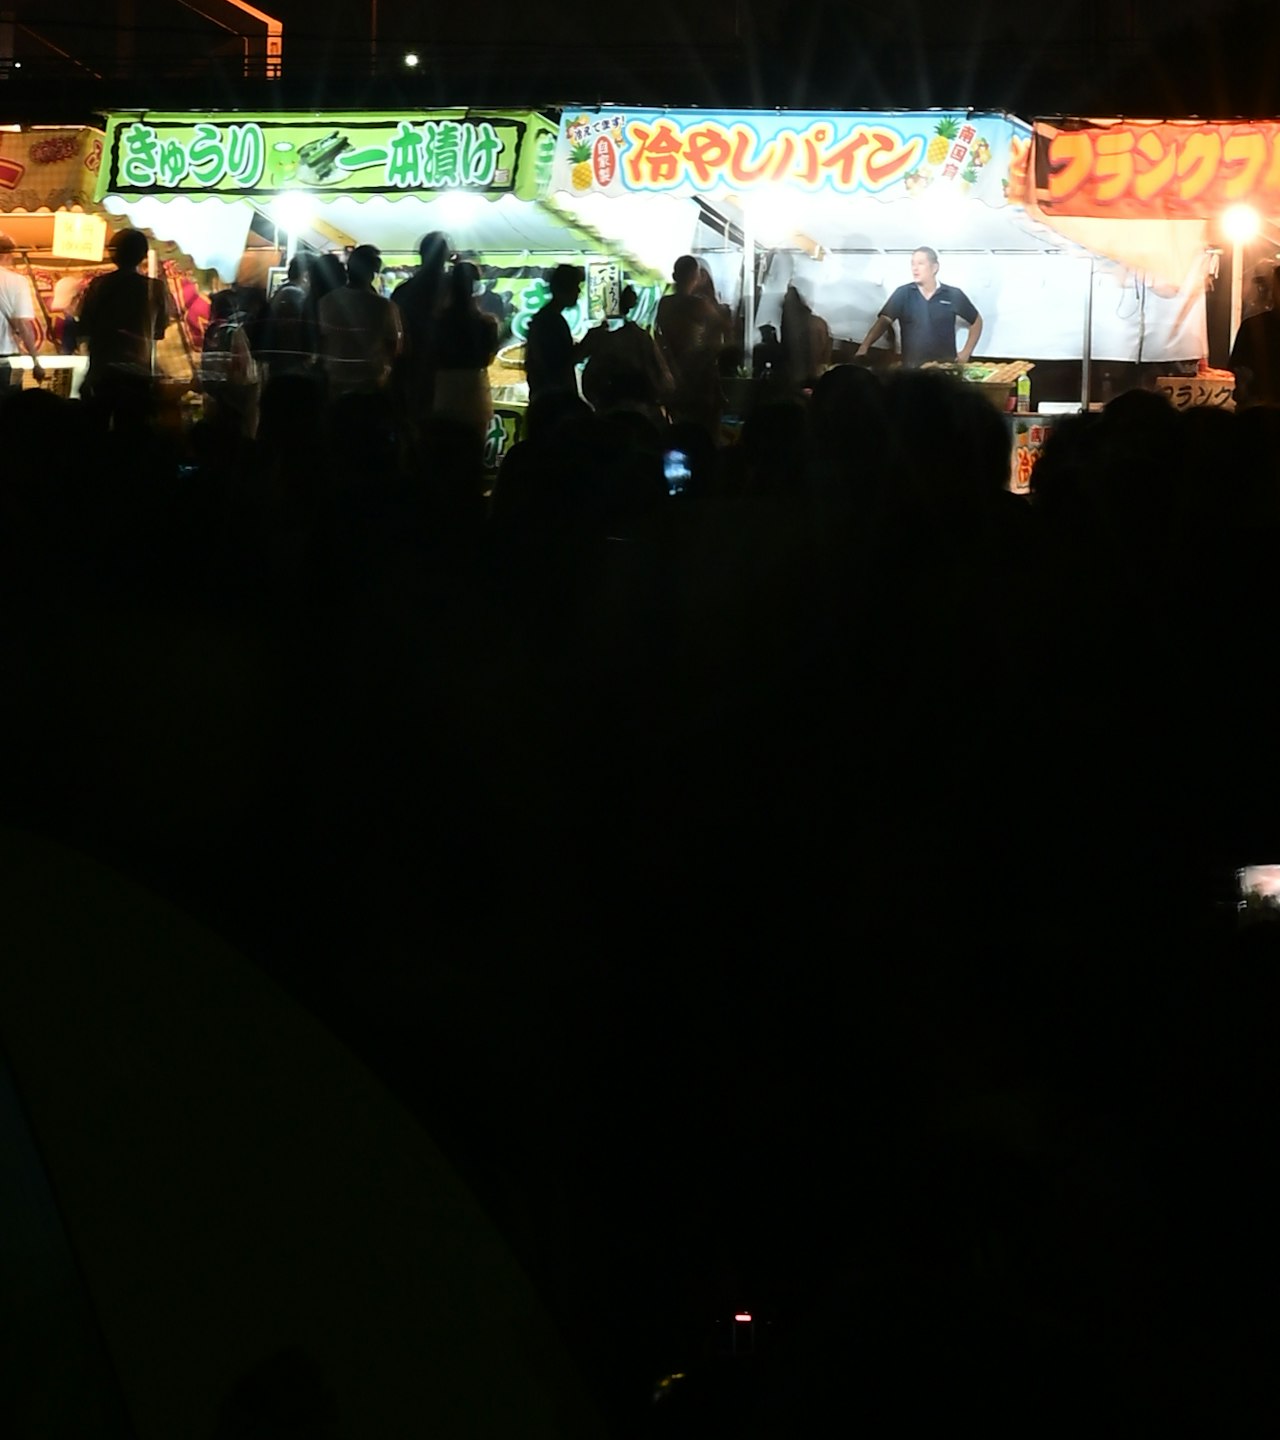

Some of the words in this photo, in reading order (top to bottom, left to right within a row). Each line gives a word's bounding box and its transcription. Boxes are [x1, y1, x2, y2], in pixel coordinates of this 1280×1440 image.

[123, 122, 265, 188] きゅうり
[335, 121, 504, 187] 一本漬け
[630, 125, 915, 184] 冷やしパイン
